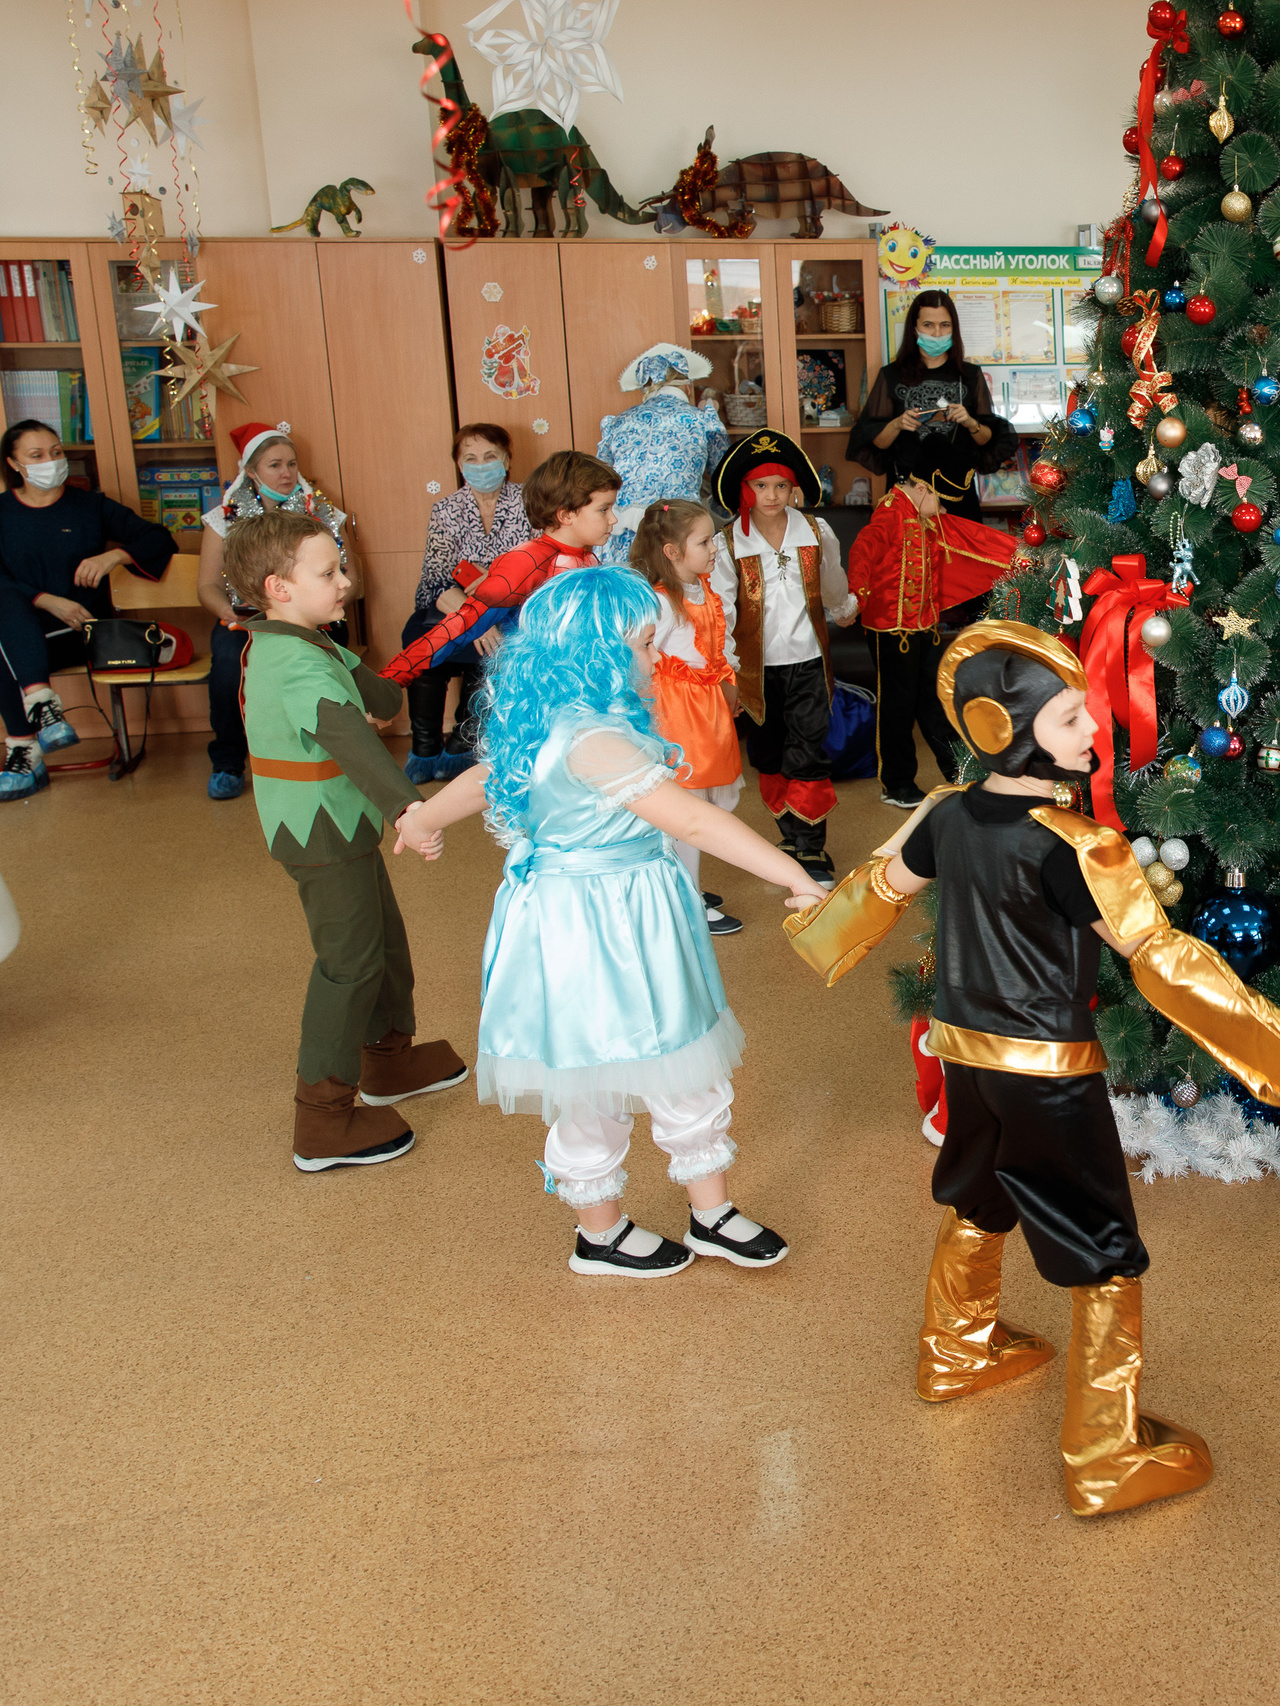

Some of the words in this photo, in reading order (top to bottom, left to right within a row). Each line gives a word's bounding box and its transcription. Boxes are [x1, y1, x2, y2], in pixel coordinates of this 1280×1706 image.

[930, 251, 1005, 270] ЛАССНЫЙ
[1007, 254, 1070, 270] УГОЛОК
[155, 471, 217, 482] СВЕТОФОР
